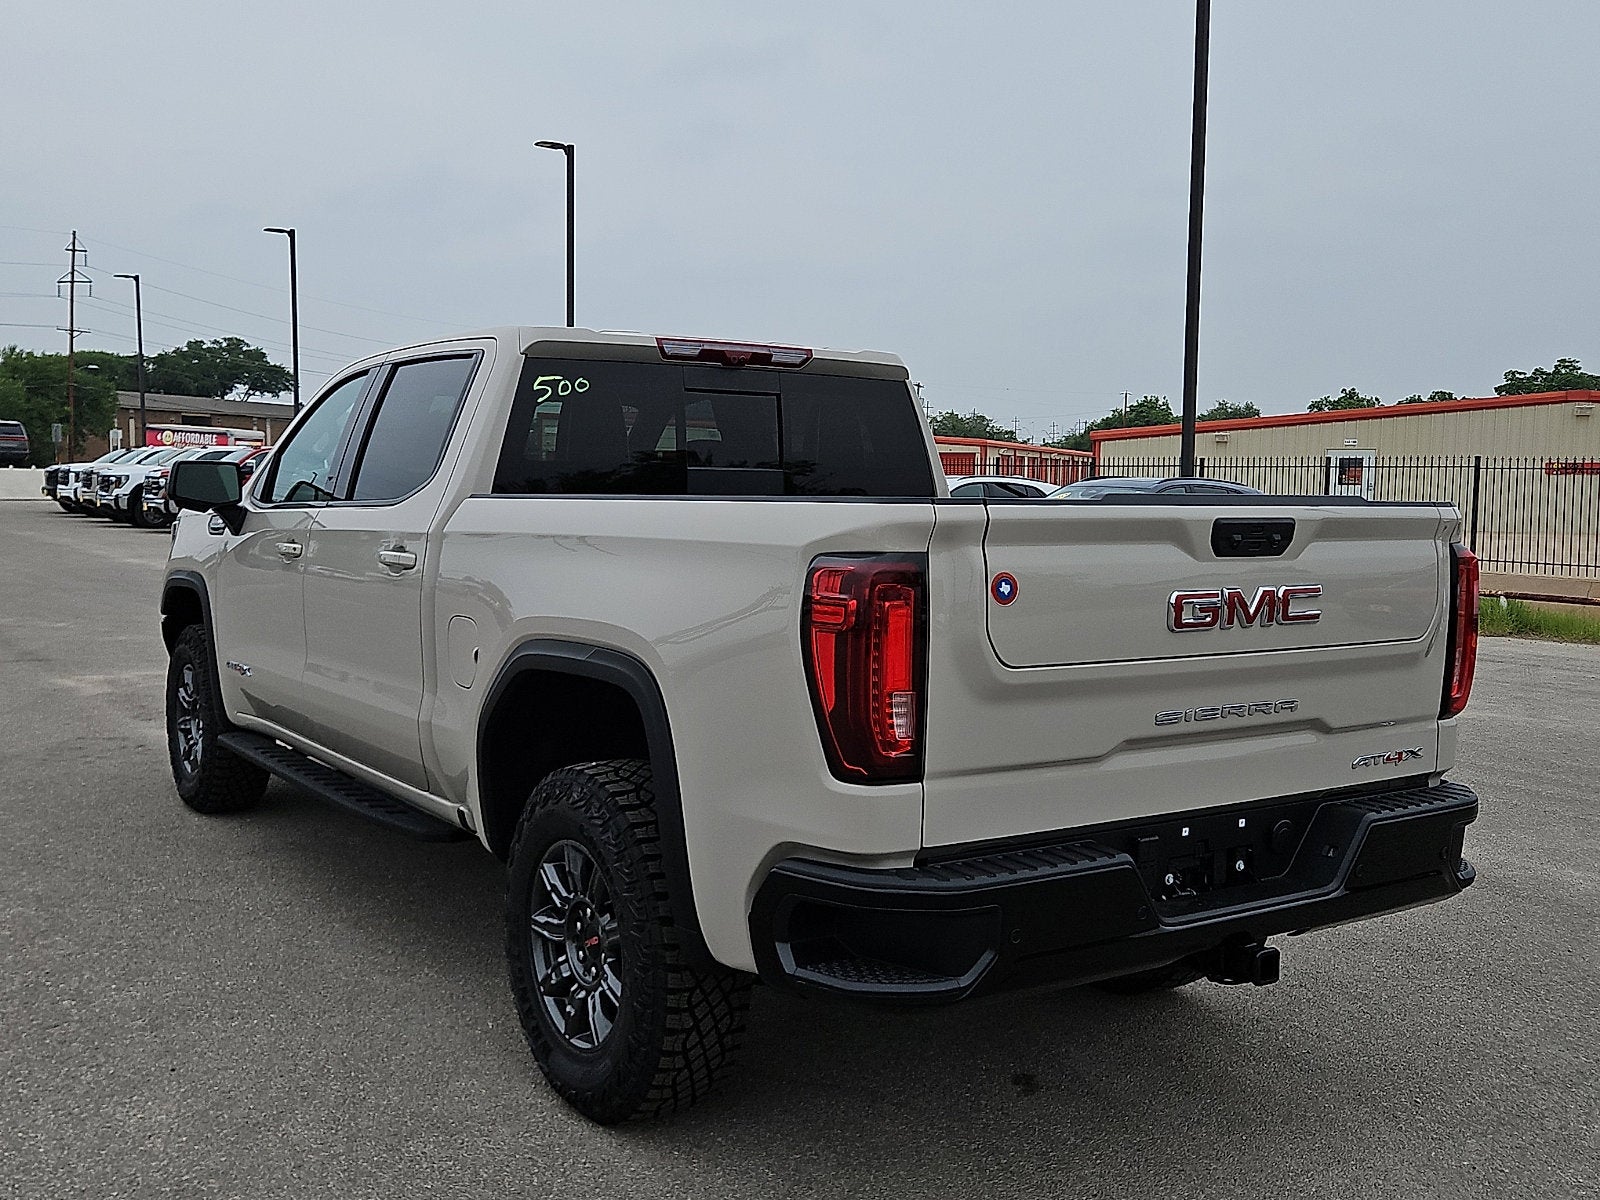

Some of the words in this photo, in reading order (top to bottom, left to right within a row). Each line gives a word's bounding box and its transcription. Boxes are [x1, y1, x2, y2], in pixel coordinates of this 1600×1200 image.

[533, 375, 590, 403] 500
[173, 431, 218, 445] AFFORDABLE
[1167, 584, 1323, 633] GMC
[1154, 698, 1300, 726] SIERRA
[1351, 746, 1424, 770] AT4X
